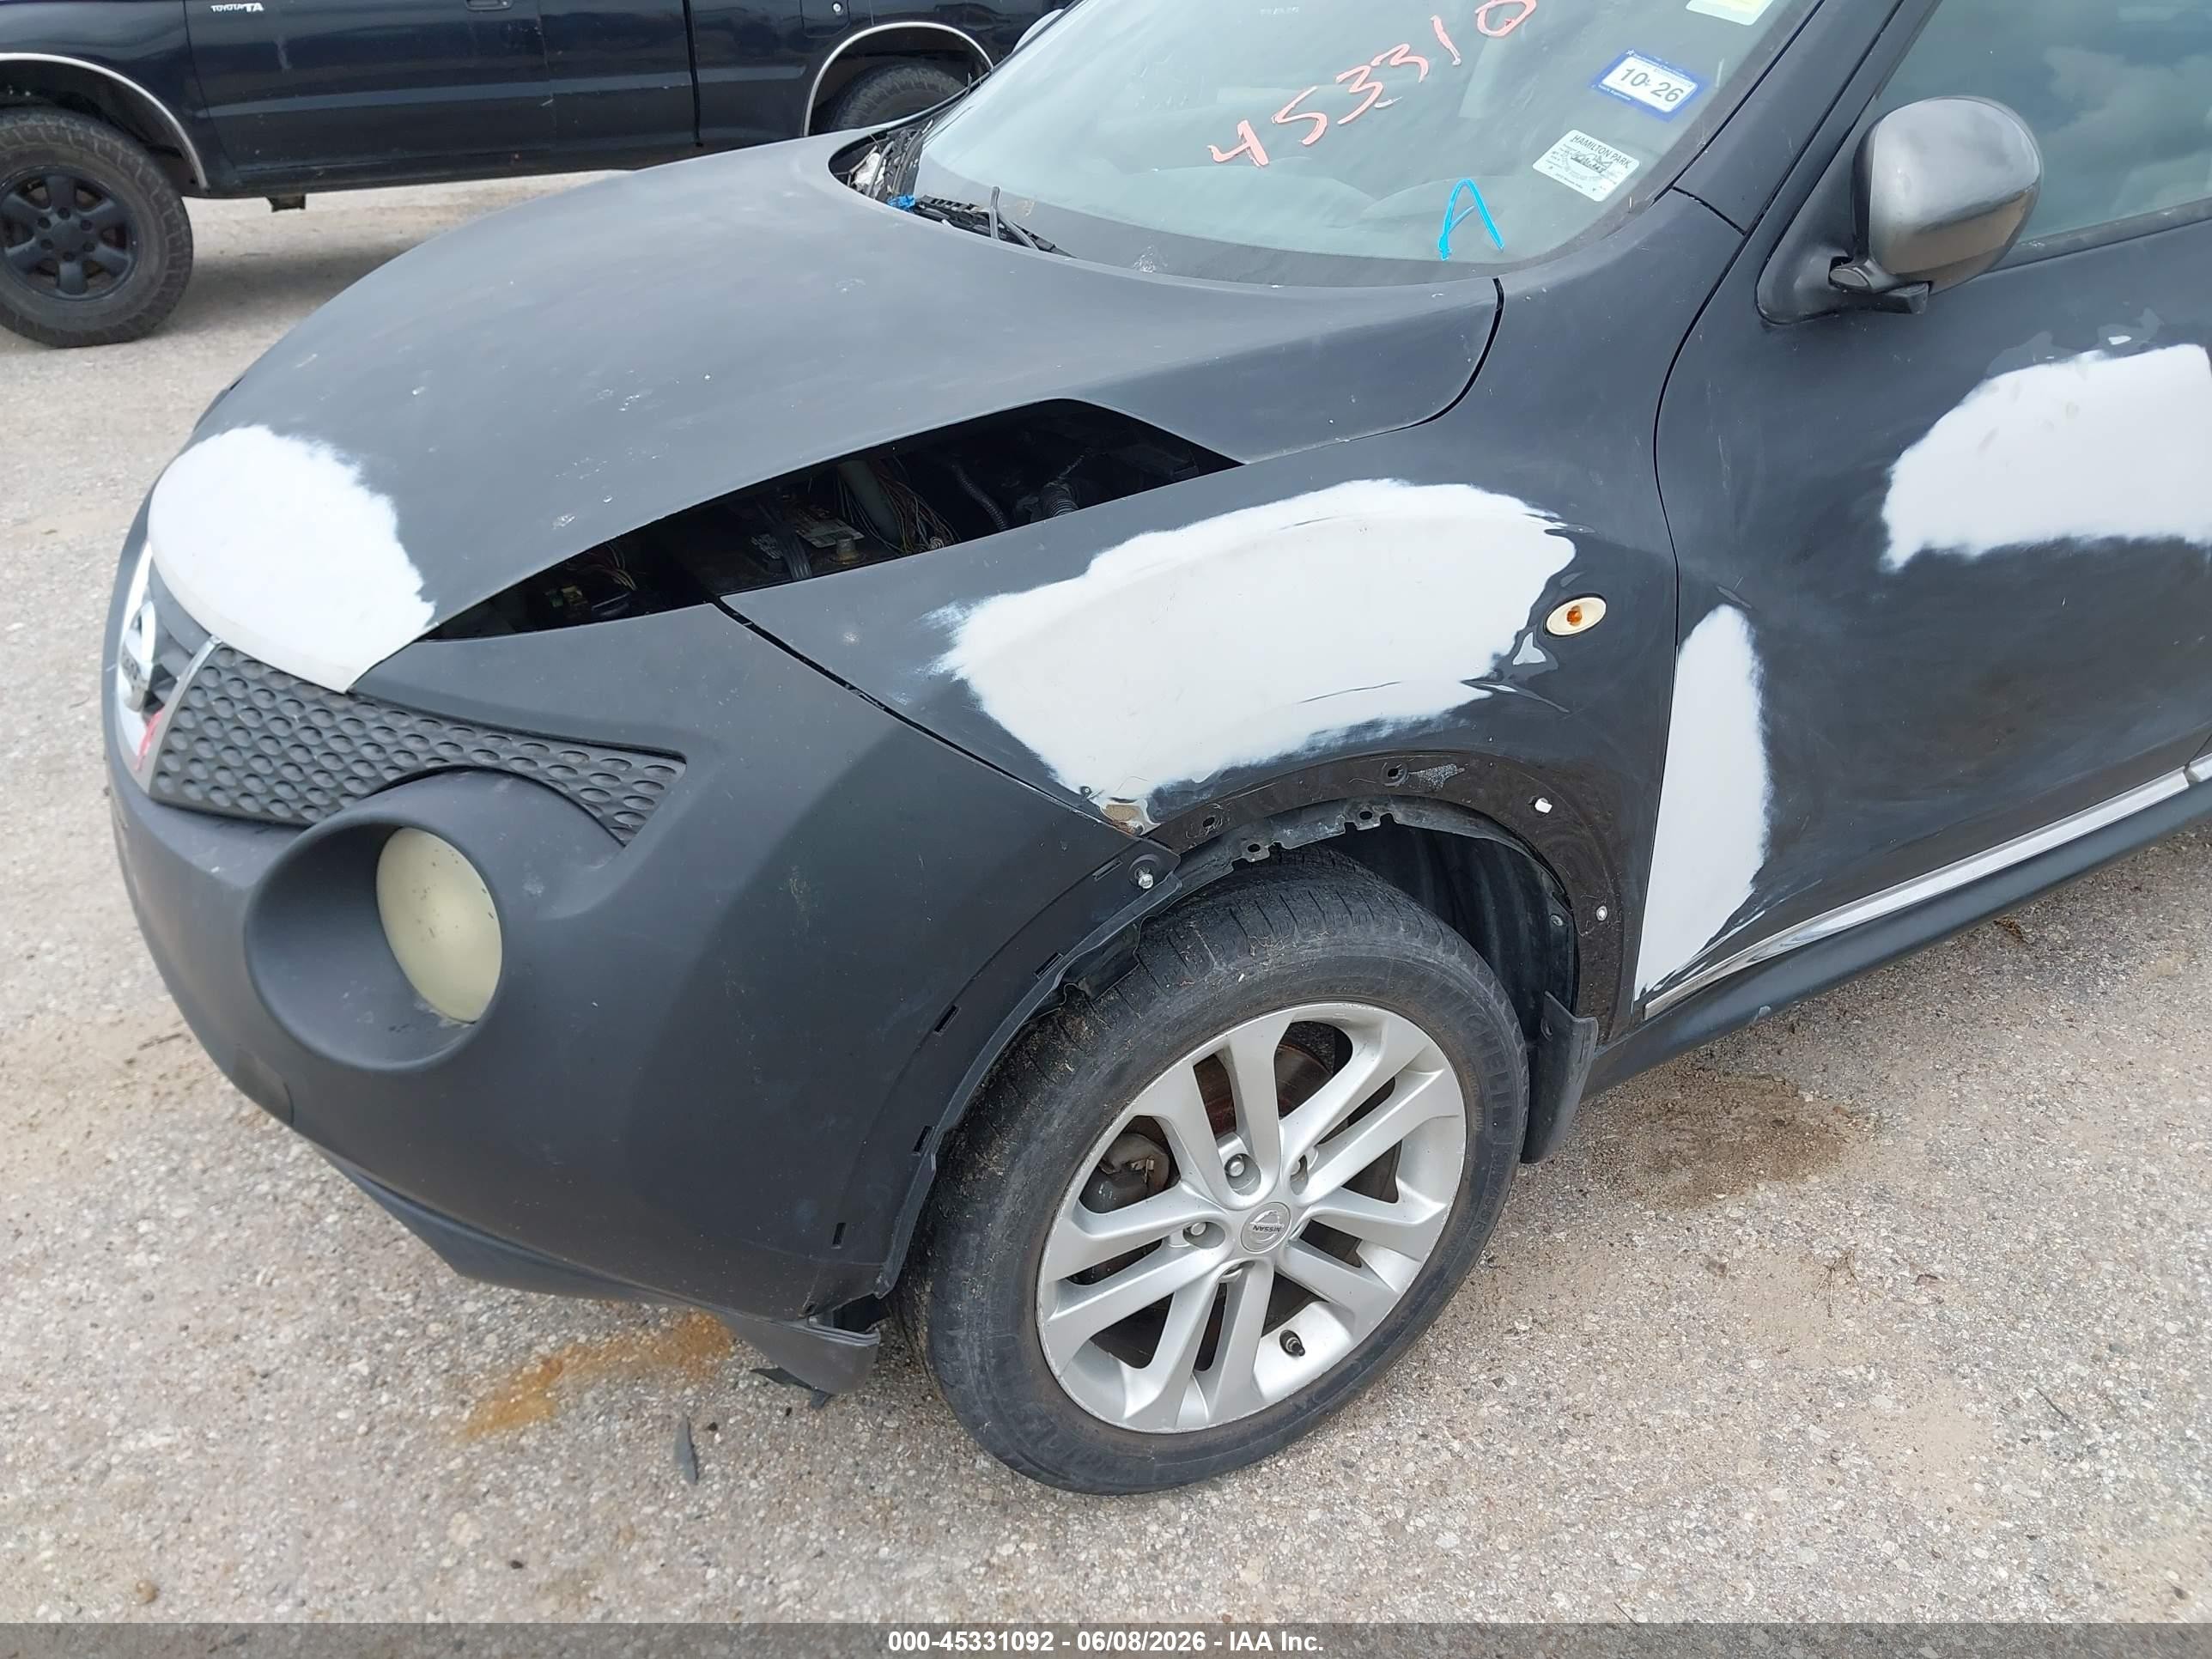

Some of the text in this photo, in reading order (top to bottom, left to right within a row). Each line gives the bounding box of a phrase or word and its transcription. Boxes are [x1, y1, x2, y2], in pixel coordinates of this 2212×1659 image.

[1620, 68, 1649, 87] 10
[1650, 82, 1684, 102] 26
[1570, 134, 1613, 158] HAMILTON
[1610, 152, 1633, 169] PARK
[1439, 179, 1504, 261] A
[1252, 1224, 1283, 1233] NISSAN
